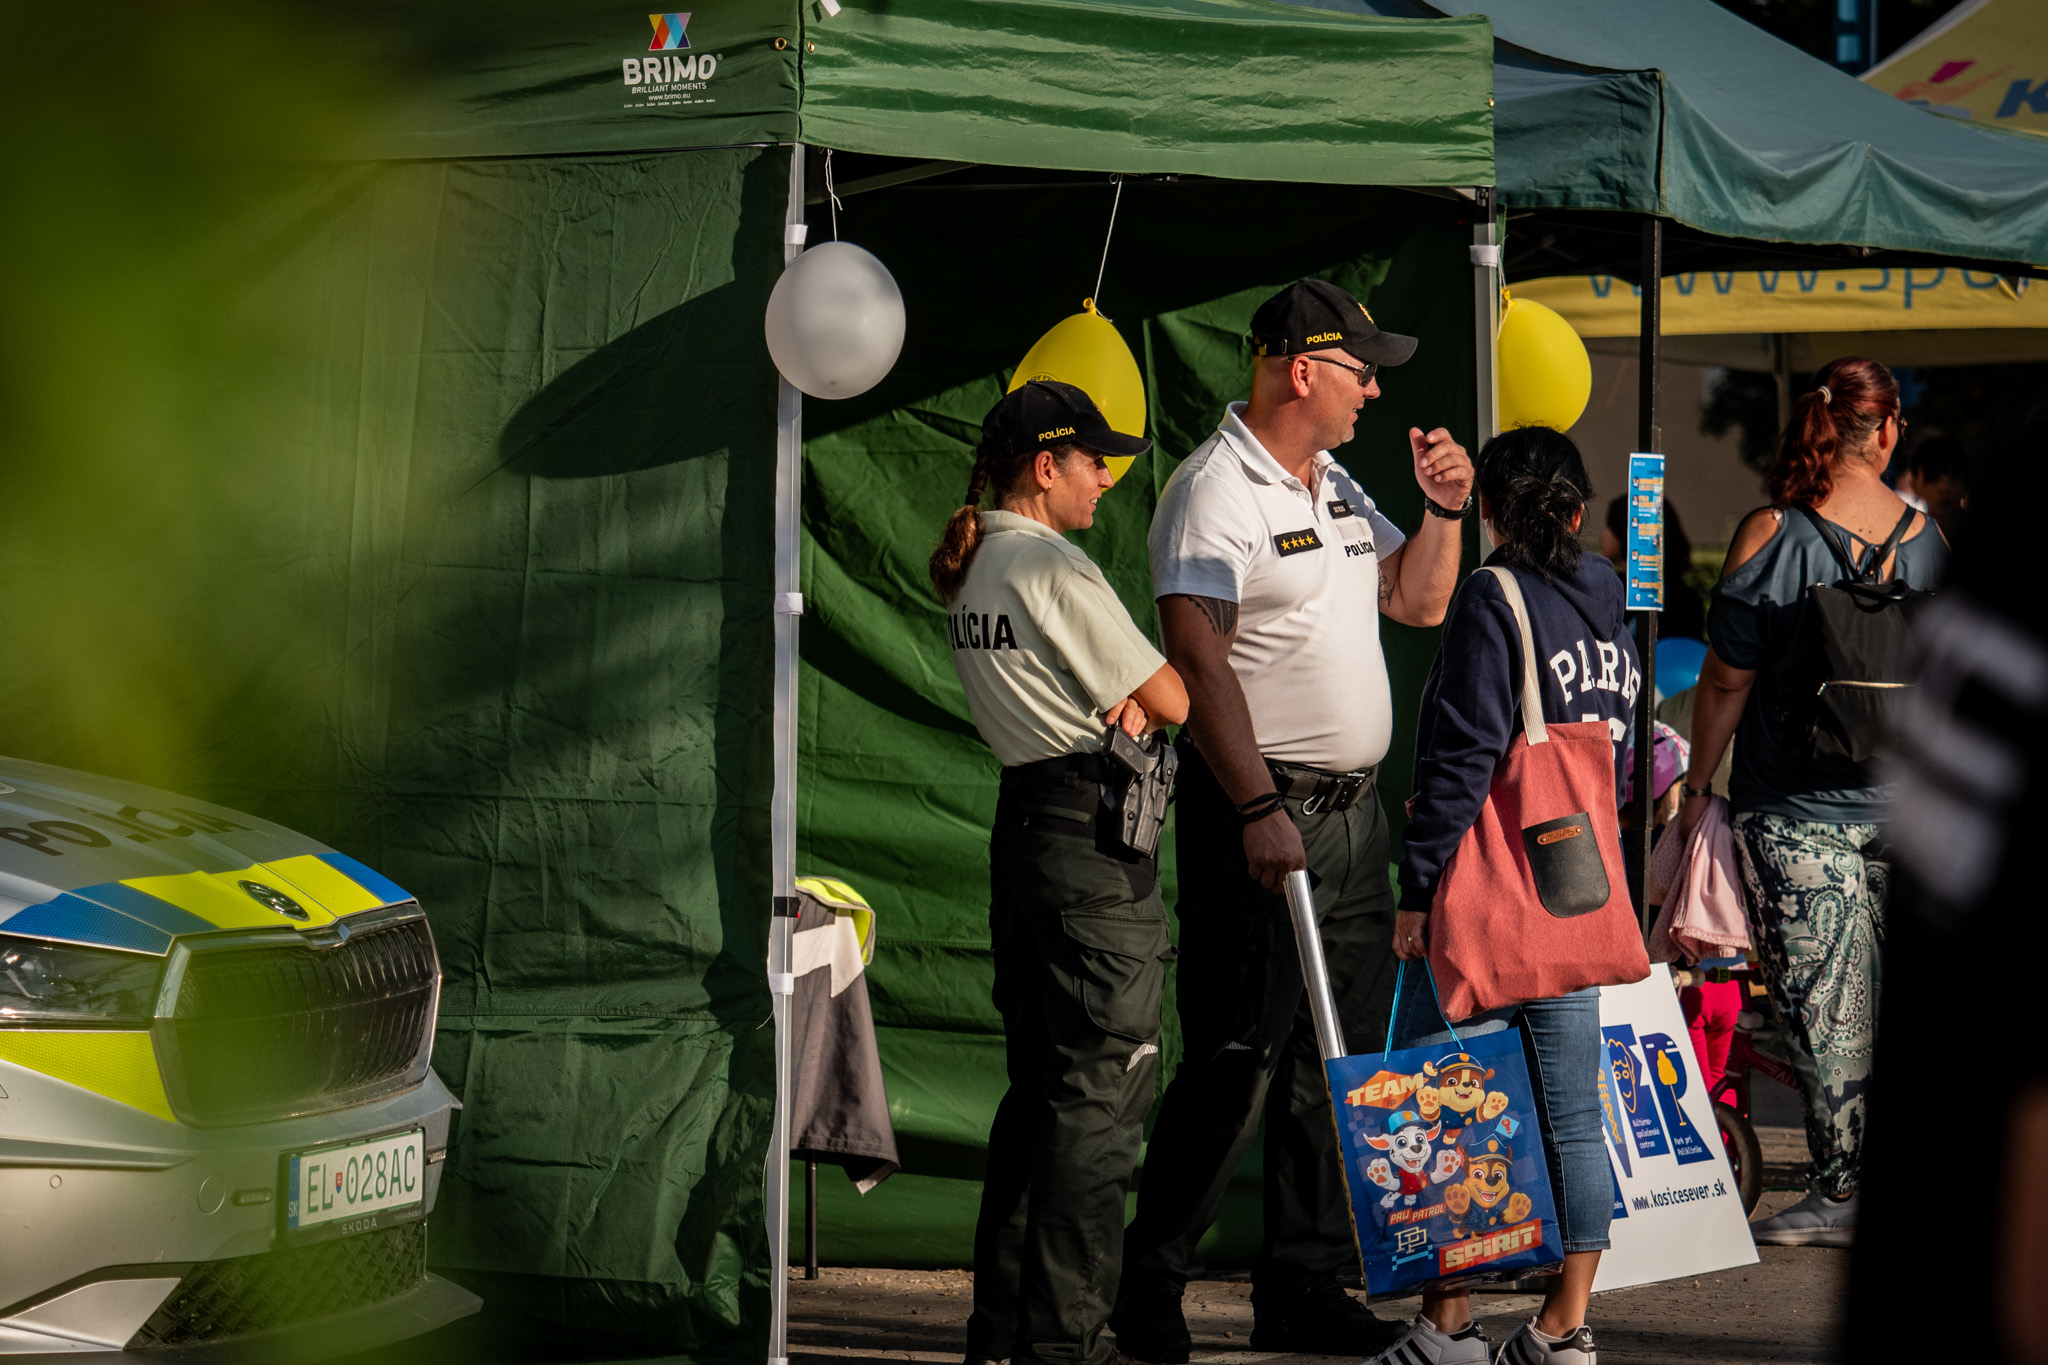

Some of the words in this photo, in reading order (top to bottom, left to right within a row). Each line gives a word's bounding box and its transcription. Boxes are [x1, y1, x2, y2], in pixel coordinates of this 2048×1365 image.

[623, 54, 717, 85] BRIMO
[631, 85, 669, 94] BRILLIANT
[671, 82, 707, 92] MOMENTS
[648, 92, 691, 101] www.brimo.eu
[1306, 332, 1343, 345] POLÍCIA
[1038, 427, 1076, 442] POLÍCIA
[947, 604, 1018, 651] OLÍCIA
[1549, 640, 1641, 709] PARIS
[1347, 1072, 1424, 1107] TEAM
[308, 1163, 334, 1214] EL
[346, 1145, 416, 1204] 028AC
[1632, 1178, 1727, 1211] www.kosicesever.sk
[288, 1200, 299, 1218] SK
[1390, 1213, 1409, 1223] PAW
[1412, 1205, 1445, 1221] PATROL
